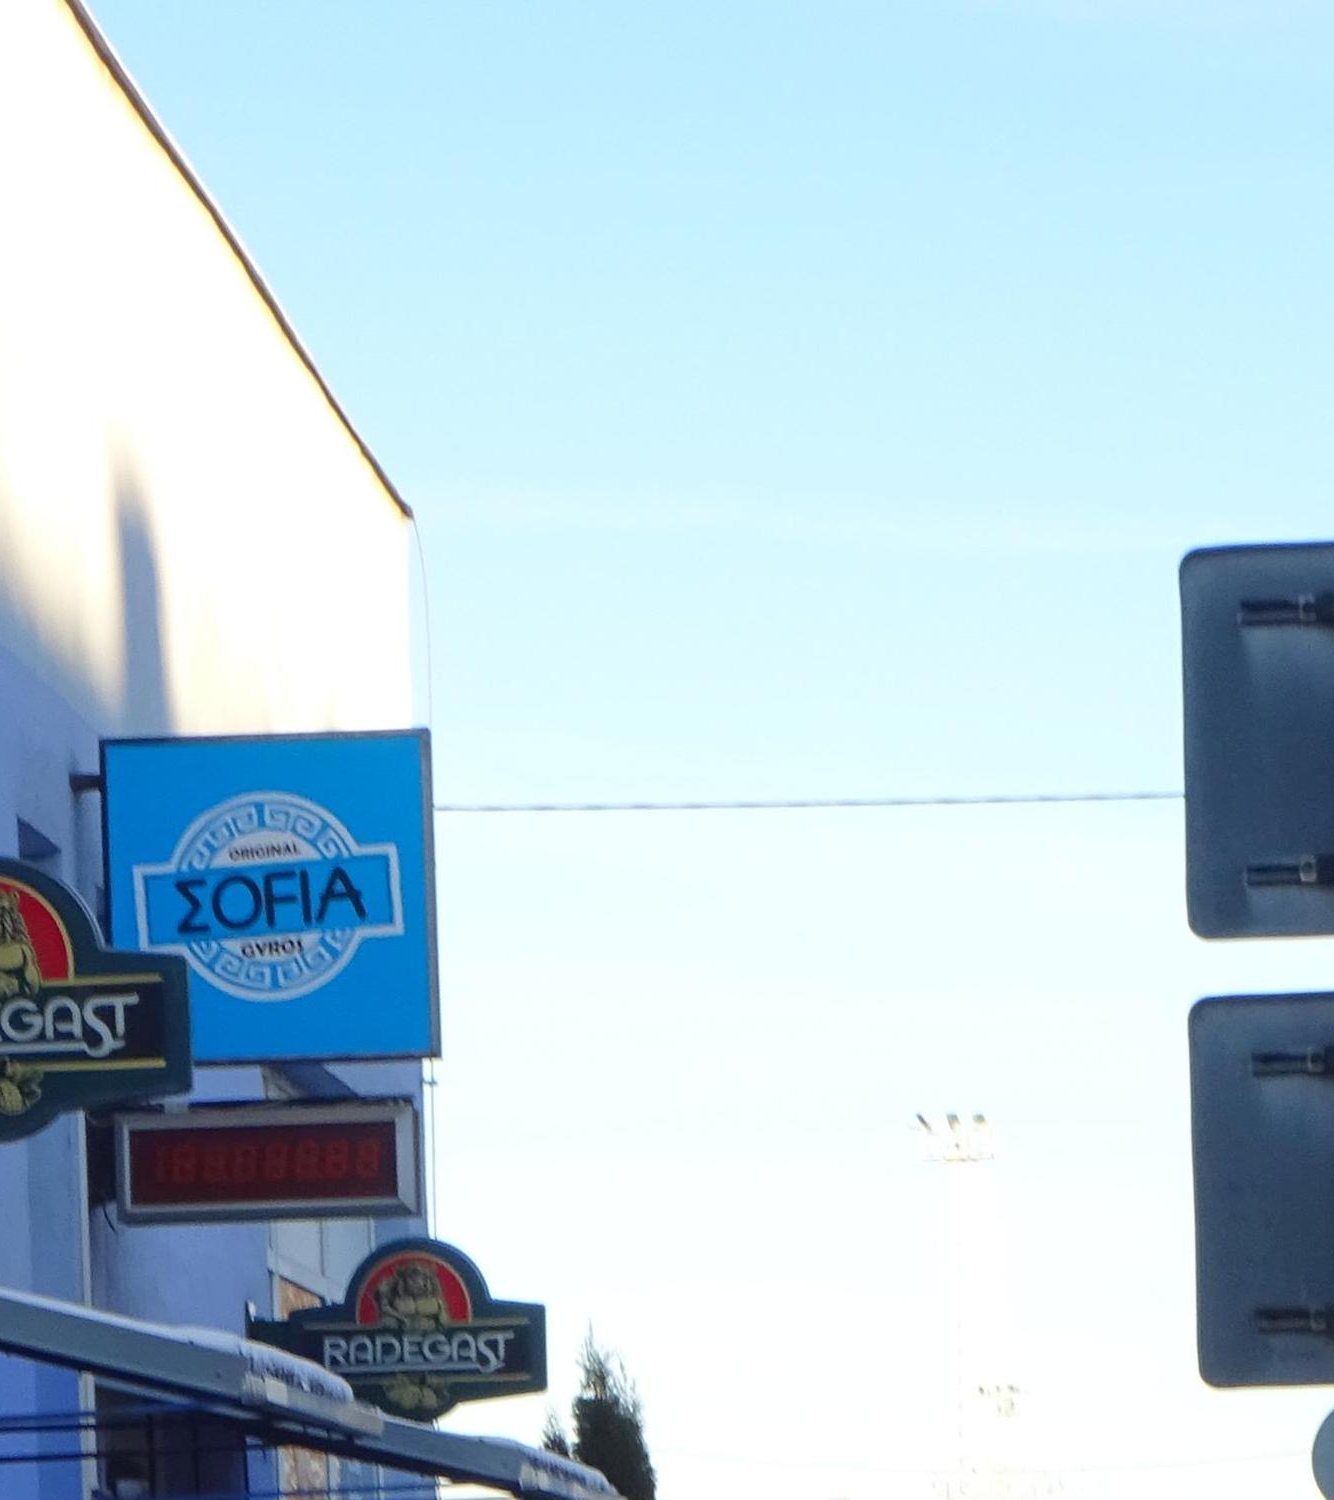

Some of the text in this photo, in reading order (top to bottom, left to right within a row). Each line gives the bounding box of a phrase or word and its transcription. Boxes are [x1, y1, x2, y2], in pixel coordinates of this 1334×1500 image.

[228, 842, 300, 862] ORIGINAL
[240, 936, 305, 959] GYROS
[323, 1329, 515, 1374] RADEGAST
